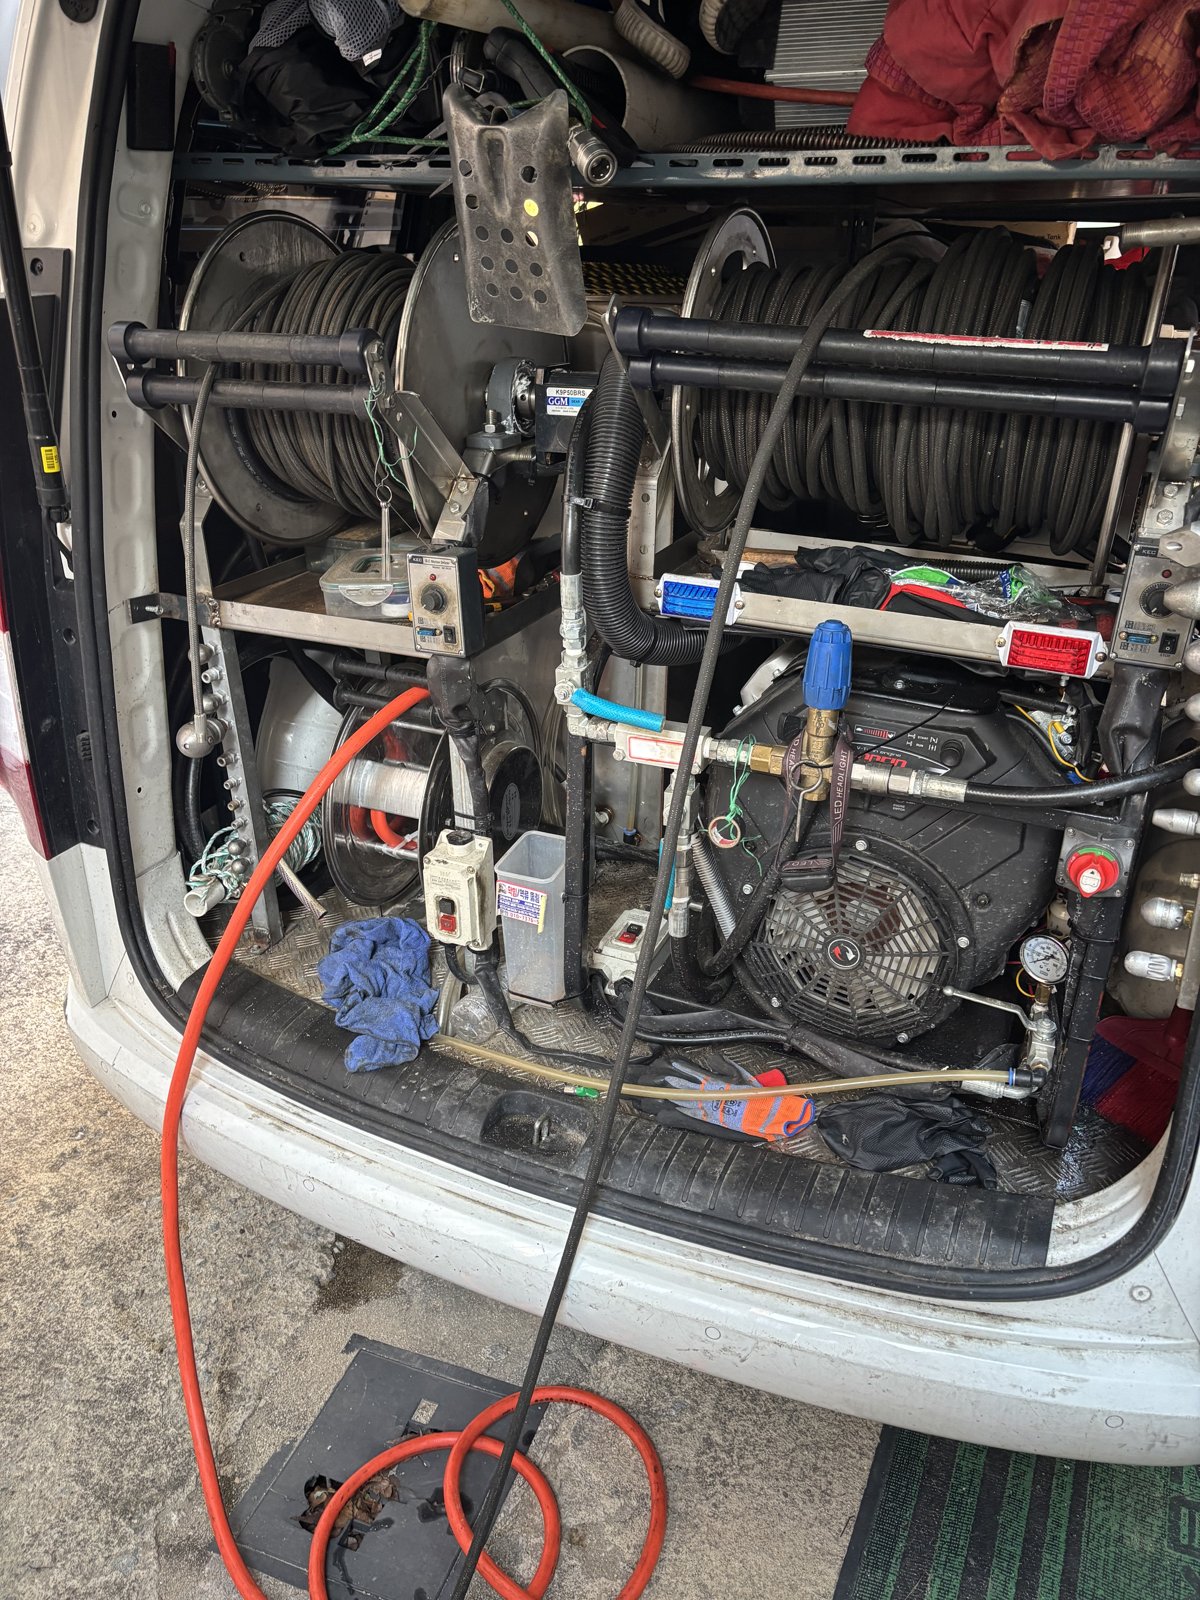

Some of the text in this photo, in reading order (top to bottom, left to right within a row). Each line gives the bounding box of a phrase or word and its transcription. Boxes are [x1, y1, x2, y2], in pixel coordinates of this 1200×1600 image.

[548, 397, 569, 406] GGM
[834, 750, 849, 821] LED HEADLIGHT
